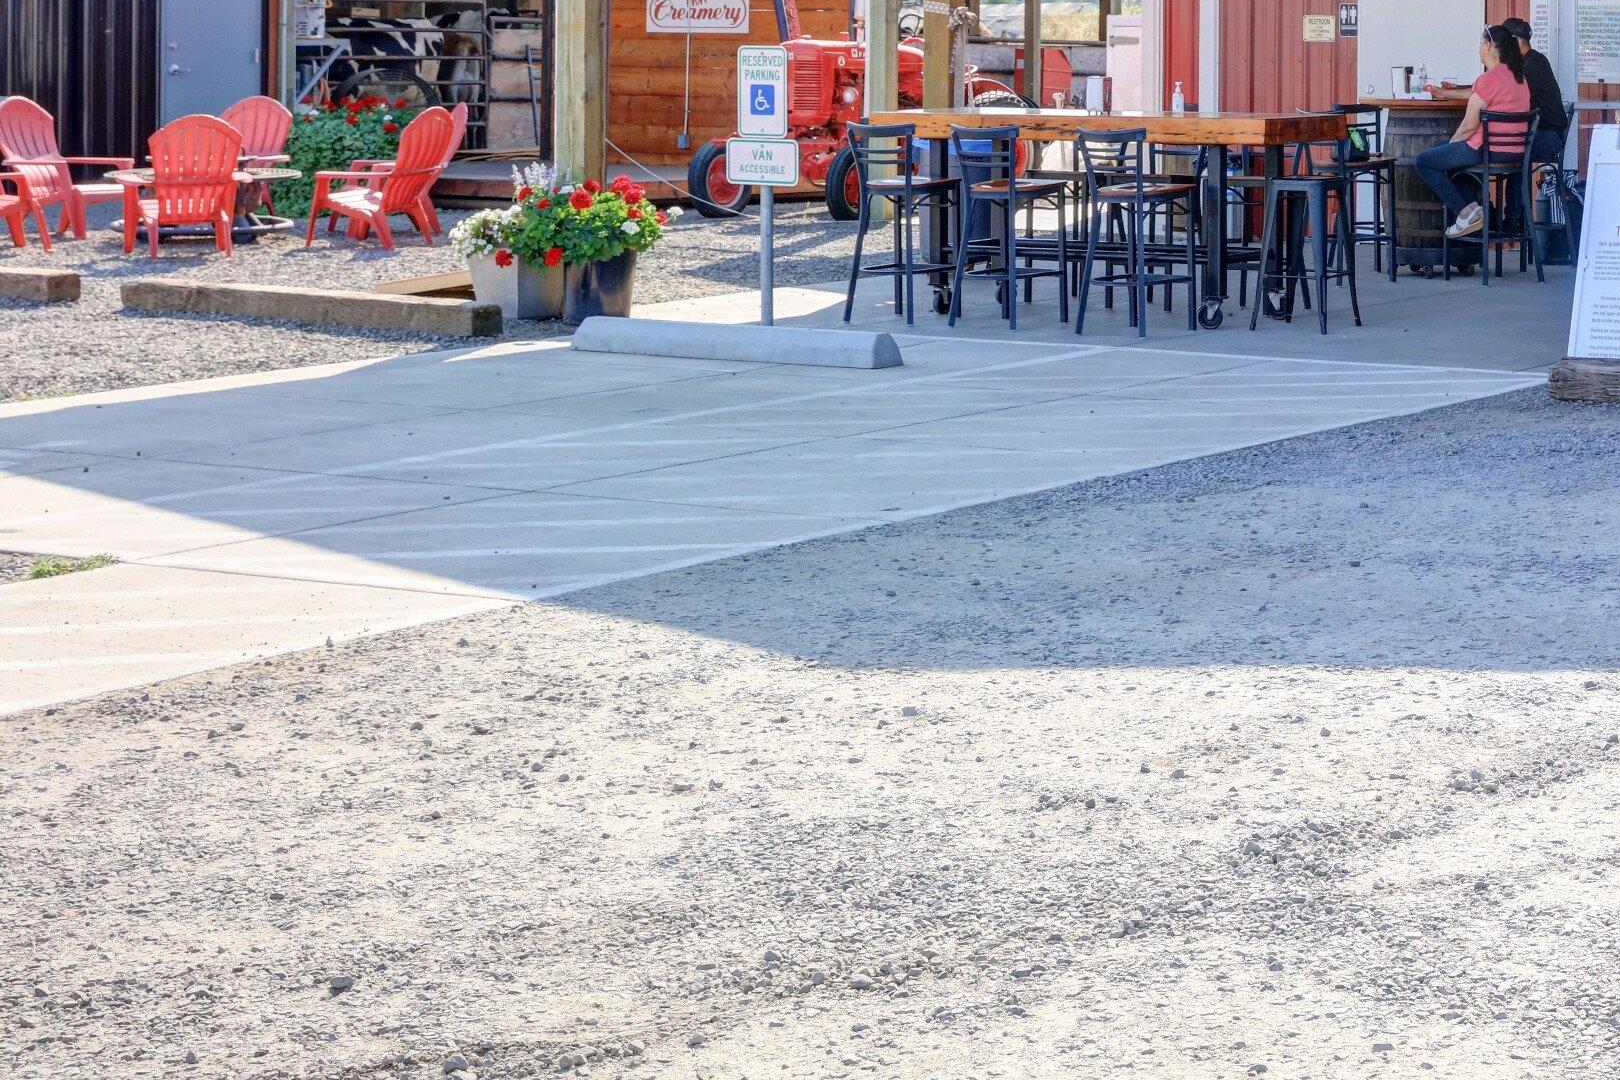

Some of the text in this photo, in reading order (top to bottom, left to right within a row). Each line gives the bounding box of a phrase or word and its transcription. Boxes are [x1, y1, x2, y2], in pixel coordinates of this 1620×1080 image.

[654, 0, 741, 26] Creamery
[742, 55, 783, 67] RESERVED
[744, 70, 780, 81] PARKING
[752, 150, 773, 160] VAN
[739, 164, 786, 174] ACCESSIBLE
